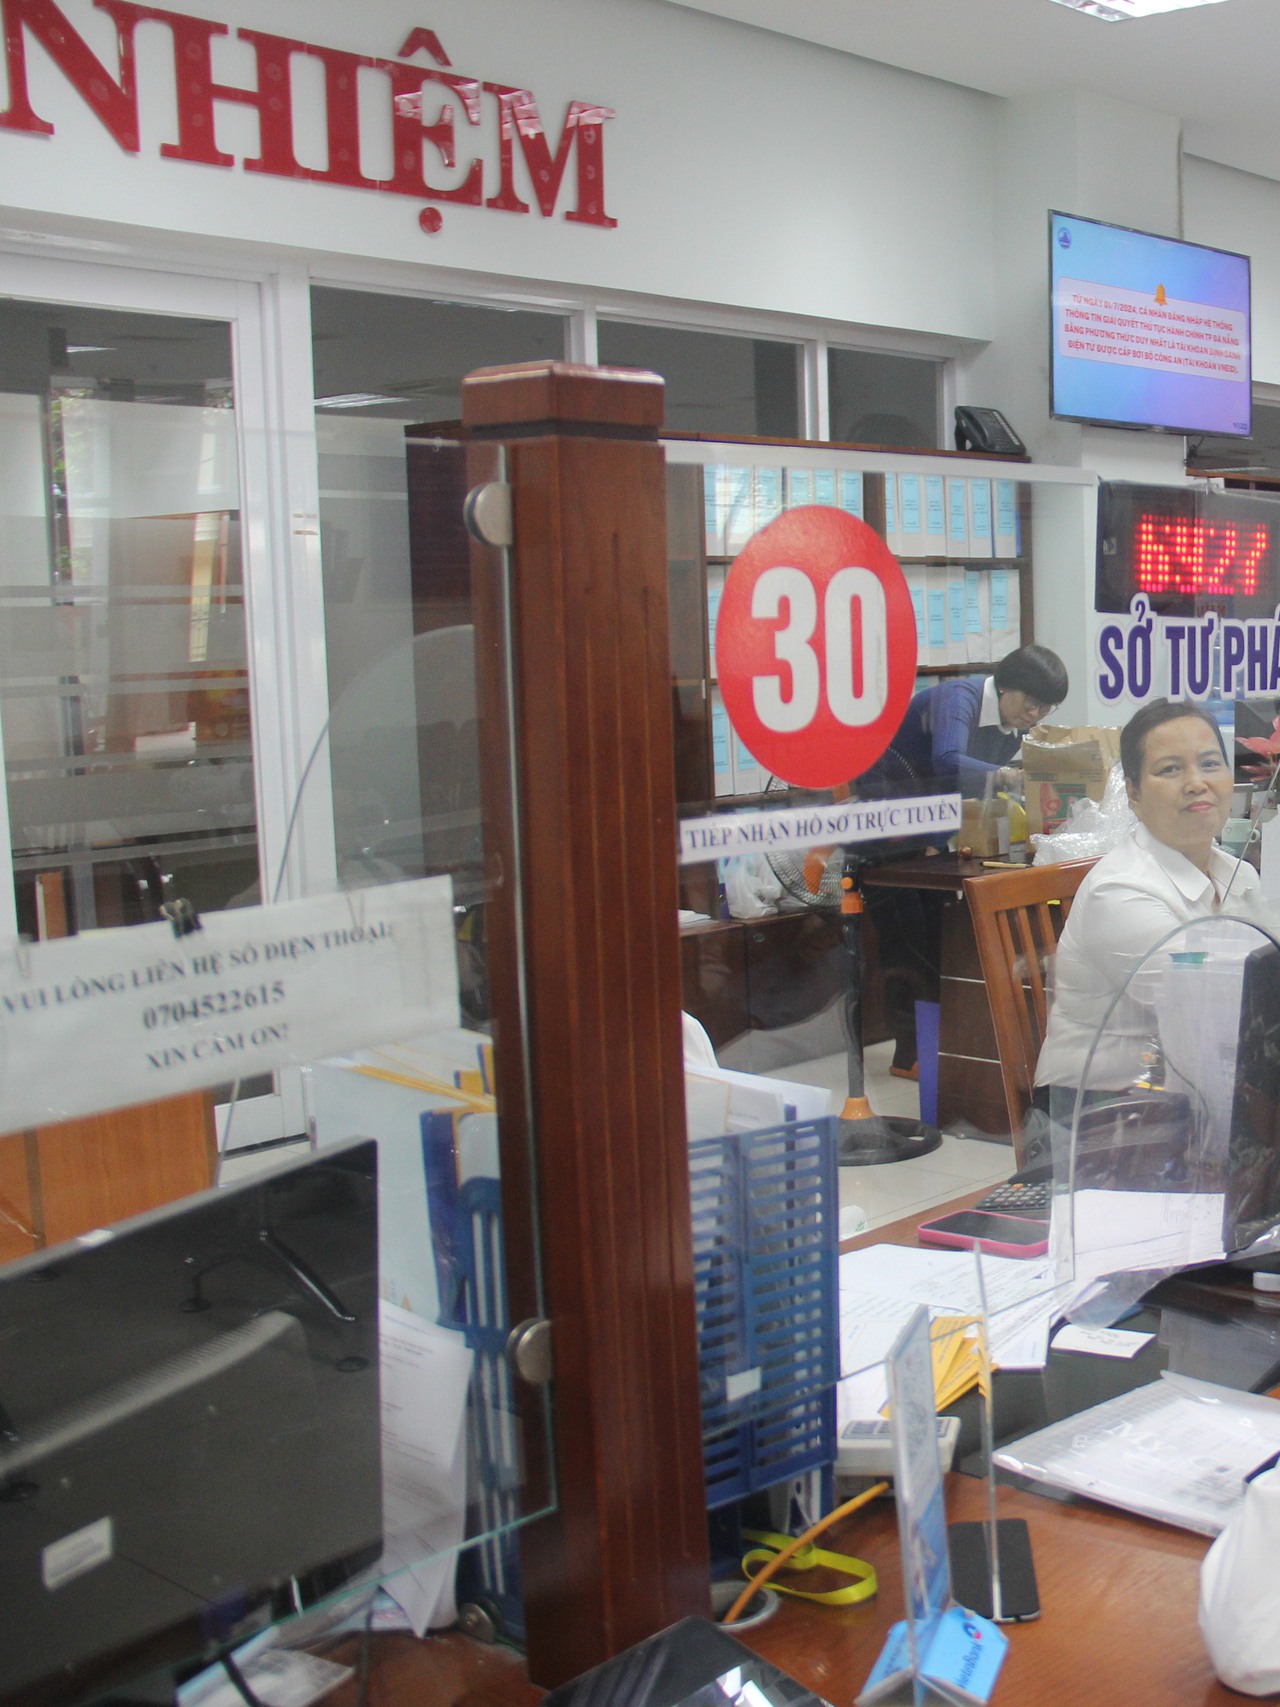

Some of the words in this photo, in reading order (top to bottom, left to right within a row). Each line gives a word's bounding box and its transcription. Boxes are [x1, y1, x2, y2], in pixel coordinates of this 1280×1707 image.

[0, 0, 617, 233] NHIỆM
[1065, 308, 1089, 320] THÔNG
[1091, 313, 1102, 322] TIN
[1118, 317, 1139, 328] QUYẾT
[1136, 335, 1149, 345] DUY
[1140, 514, 1267, 594] 6927
[752, 566, 888, 733] 30
[1100, 600, 1153, 699] SỞ
[1165, 618, 1214, 695] TƯ
[685, 821, 732, 849] TIẾP
[737, 817, 790, 845] NHẬN
[795, 812, 823, 838] HỒ
[826, 813, 850, 833] SƠ
[853, 806, 901, 831] TRỰC
[904, 800, 959, 825] TUYẾN
[2, 990, 48, 1015] VUI
[51, 970, 127, 1004] LÒNG
[130, 958, 187, 990] LIÊN
[192, 953, 224, 980] HỆ
[229, 940, 260, 967] SỐ
[265, 936, 317, 965] ĐIỆN
[142, 981, 286, 1030] 0704522615
[146, 1045, 190, 1072] XIN
